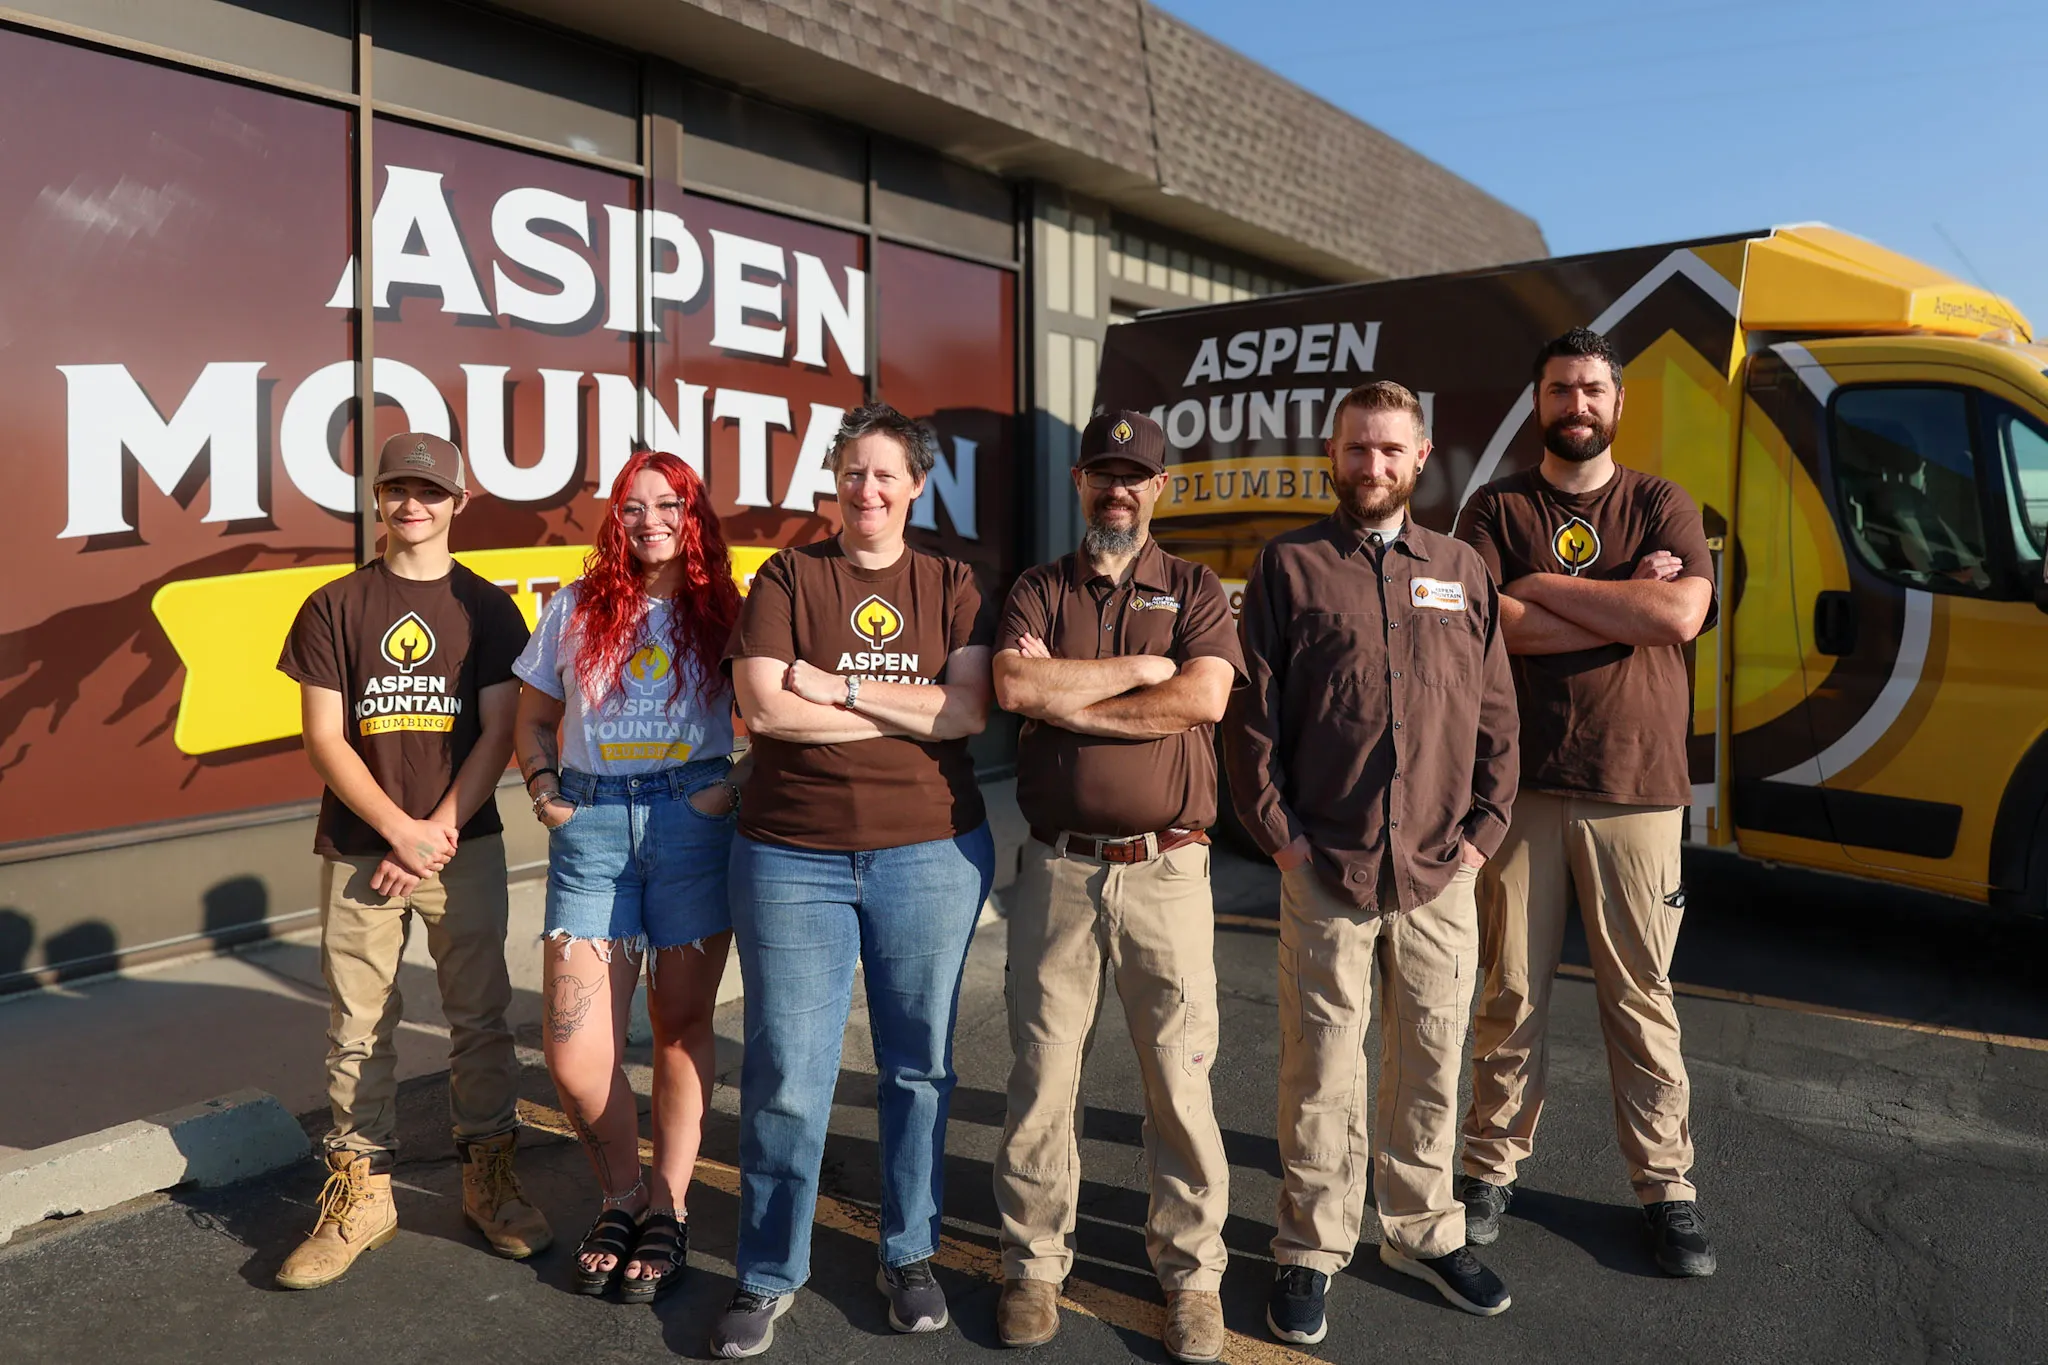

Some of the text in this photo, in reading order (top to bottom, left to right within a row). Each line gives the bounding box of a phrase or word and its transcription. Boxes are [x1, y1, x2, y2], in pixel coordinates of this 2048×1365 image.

[325, 165, 867, 377] ASPEN
[1182, 321, 1383, 388] ASPEN
[56, 357, 979, 541] MOUNTAN
[1172, 467, 1340, 503] PLUMBIN
[836, 652, 919, 672] ASPEN
[364, 675, 446, 696] ASPEN
[605, 698, 687, 718] ASPEN
[366, 718, 445, 732] PLUMBING
[584, 720, 705, 745] MOUNTAIN
